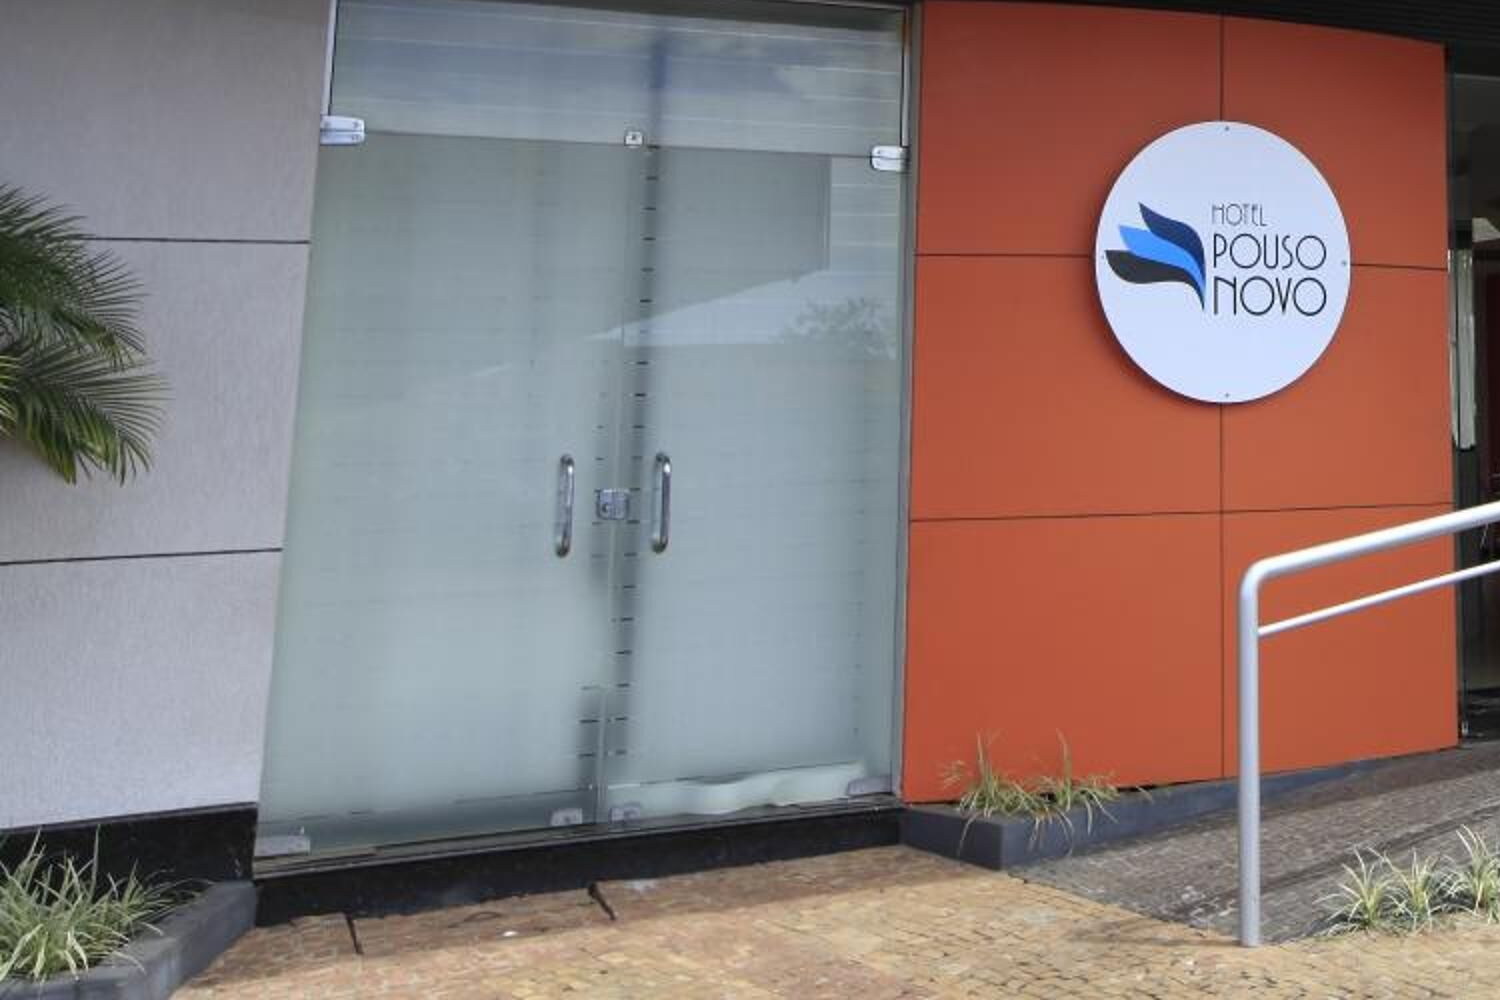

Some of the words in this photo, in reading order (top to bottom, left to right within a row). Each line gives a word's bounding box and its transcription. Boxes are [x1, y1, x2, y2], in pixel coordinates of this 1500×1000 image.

[1211, 203, 1268, 227] HOTEL
[1212, 233, 1327, 270] POUSO
[1212, 275, 1327, 316] NOVO
